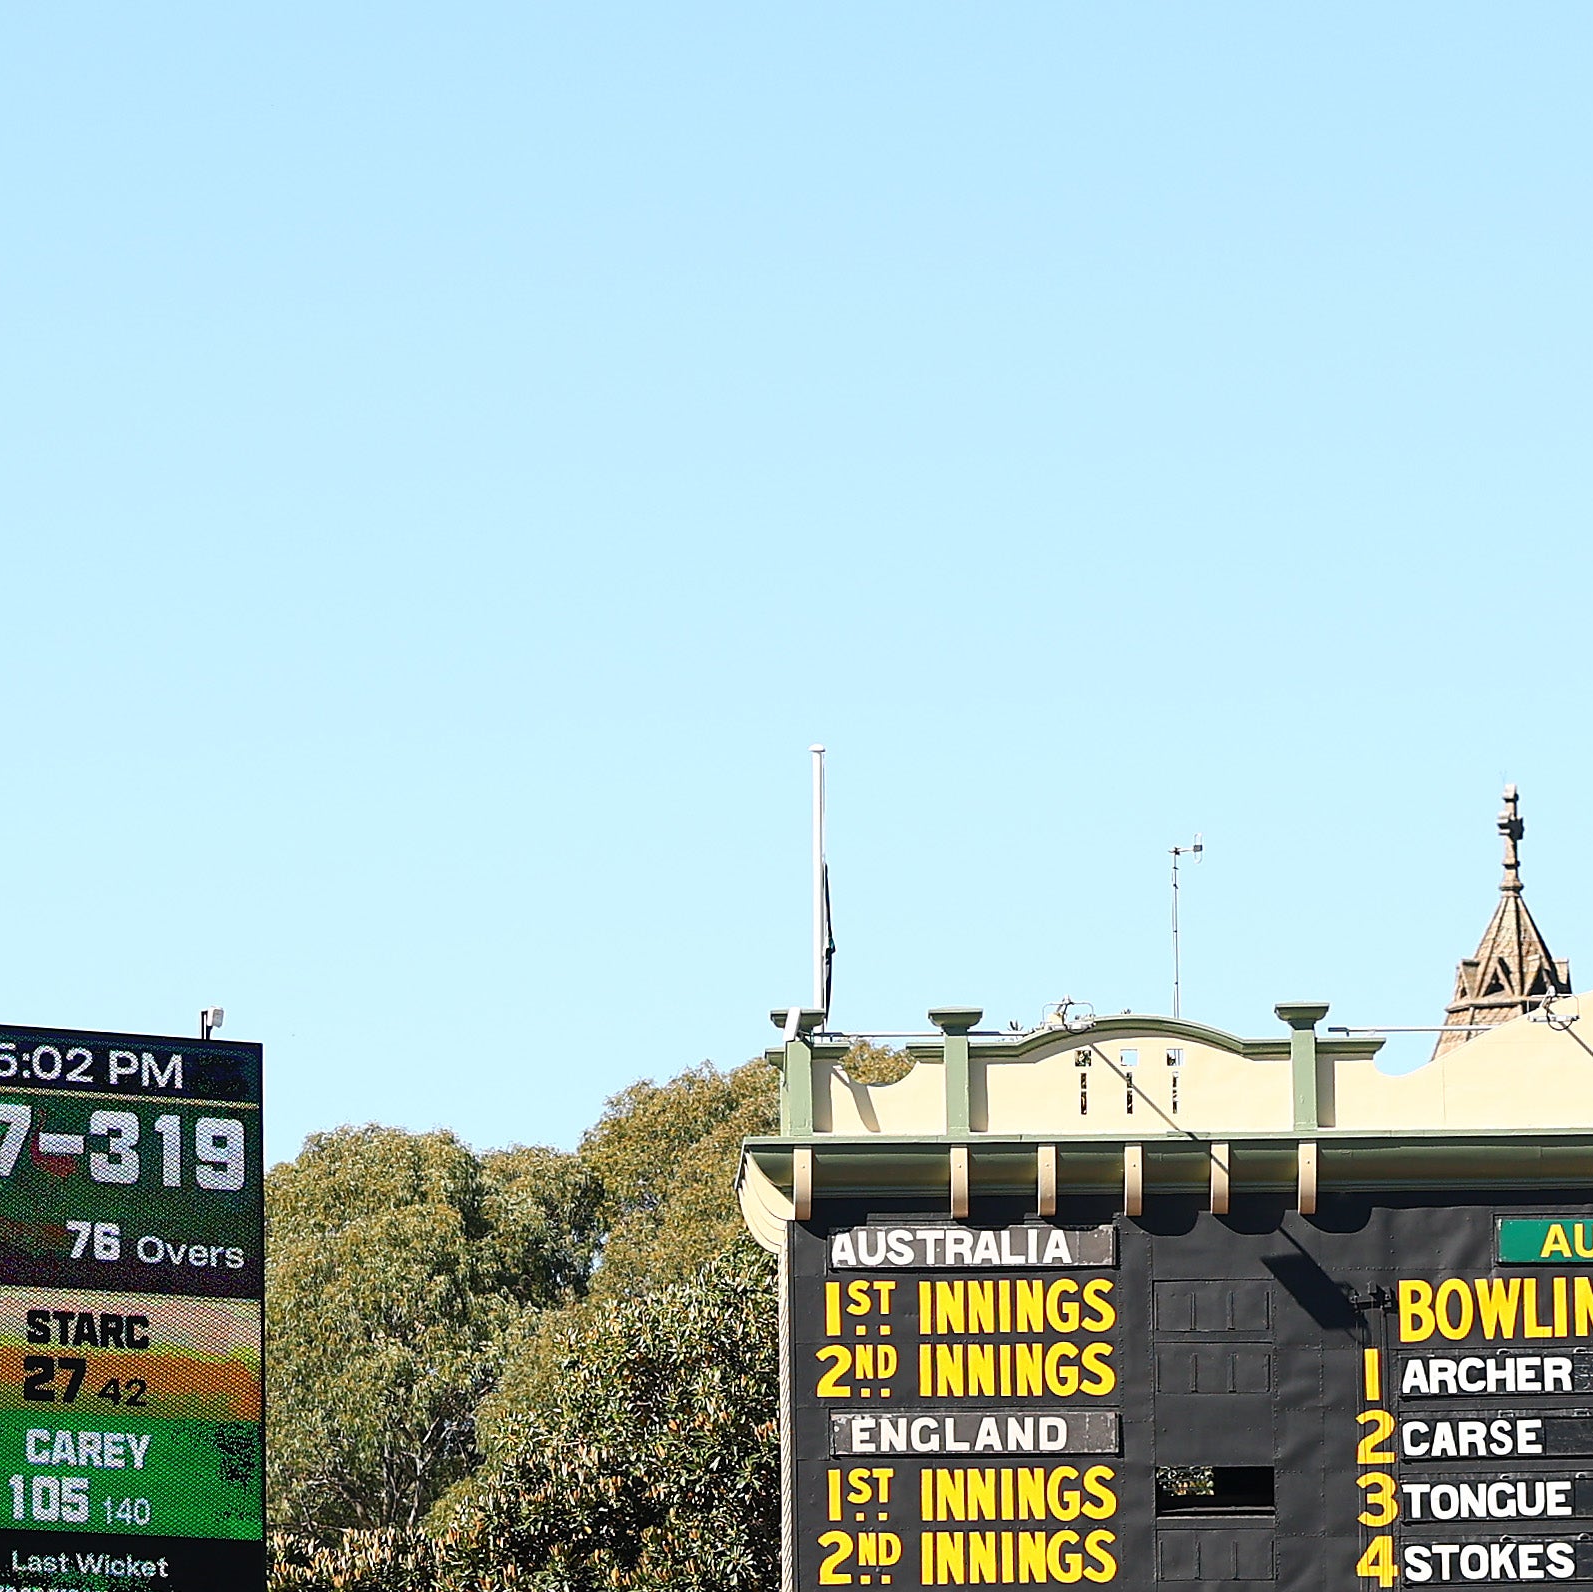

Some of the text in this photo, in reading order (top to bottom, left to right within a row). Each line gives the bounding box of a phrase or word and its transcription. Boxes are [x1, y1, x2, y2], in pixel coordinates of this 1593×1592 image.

[109, 1050, 183, 1089] PM
[67, 1221, 245, 1269] 76 Overs
[831, 1229, 1073, 1266] AUSTRALIA
[919, 1279, 1116, 1336] INNINGS
[27, 1309, 150, 1350] STARC
[23, 1356, 147, 1406] 27 42
[918, 1341, 1116, 1398] INNINGS
[1401, 1357, 1573, 1393] ARCHER
[25, 1429, 152, 1470] CAREY
[851, 1417, 1068, 1453] ENGLAND
[1401, 1420, 1543, 1457] CARSE
[9, 1475, 151, 1526] 105 140
[920, 1465, 1118, 1522] INNINGS
[1401, 1481, 1573, 1520] TONGUE
[11, 1550, 169, 1579] Last Wicket
[921, 1529, 1118, 1586] INNINGS
[1402, 1544, 1576, 1582] STOKES
